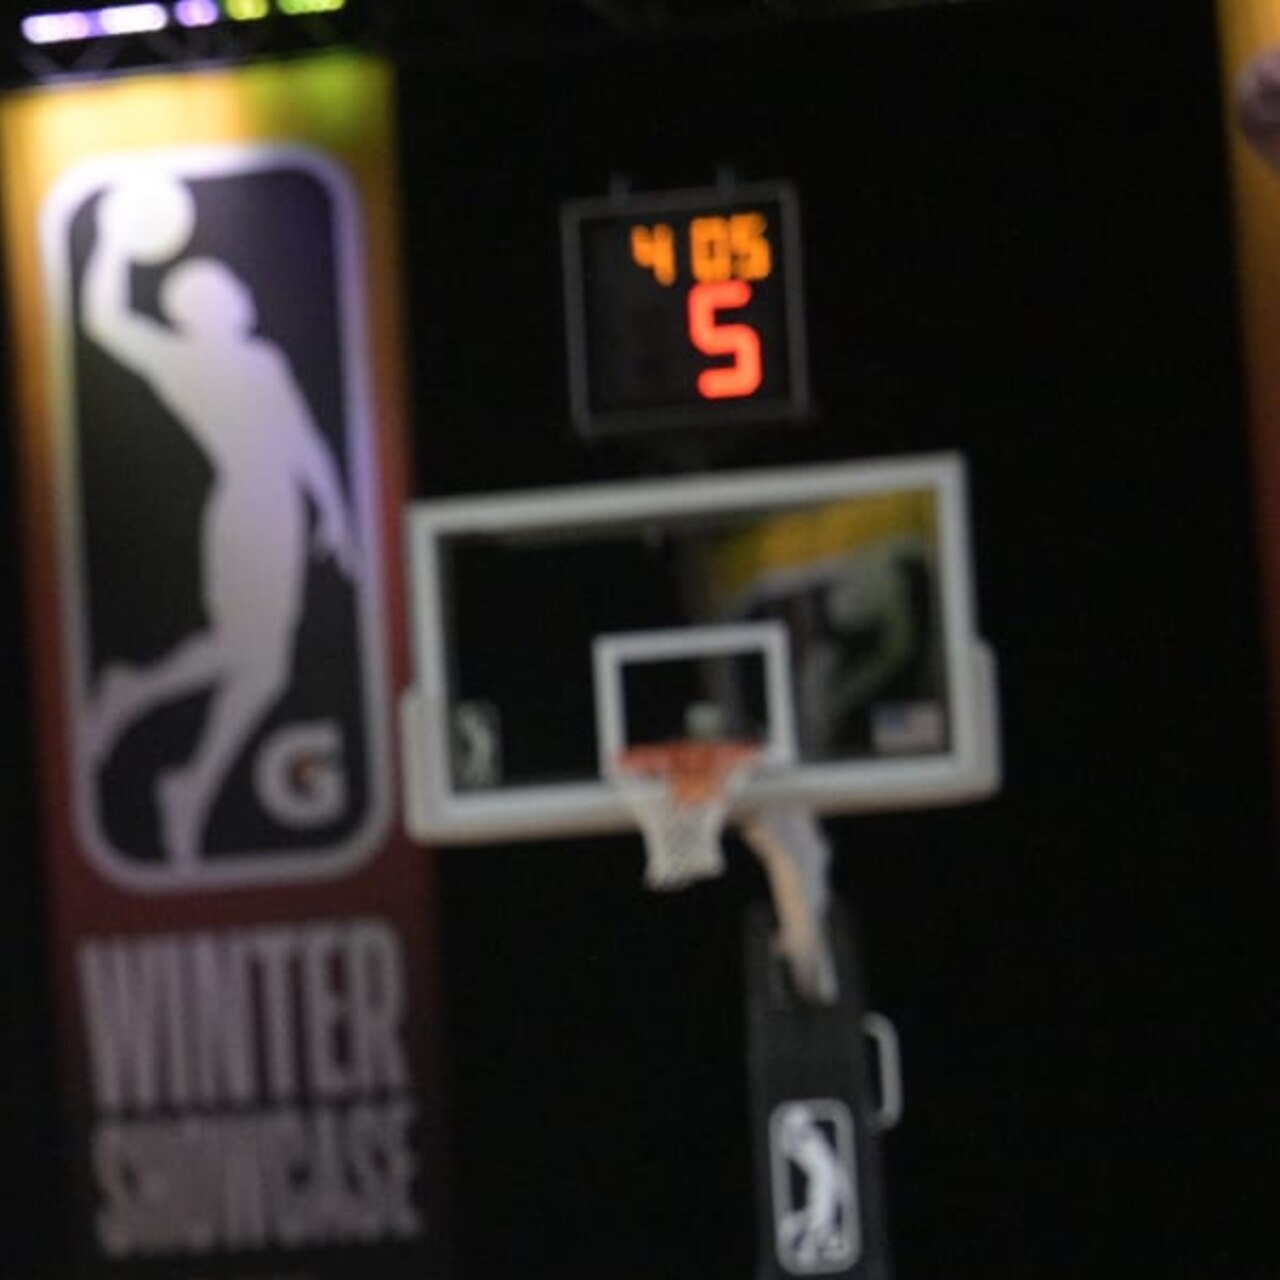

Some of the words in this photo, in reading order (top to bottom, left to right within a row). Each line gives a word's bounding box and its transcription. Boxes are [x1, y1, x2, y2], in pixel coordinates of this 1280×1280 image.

[688, 278, 763, 399] 5
[252, 717, 347, 828] G
[77, 918, 410, 1108] WINTER
[90, 1104, 422, 1260] SHOWCASE
